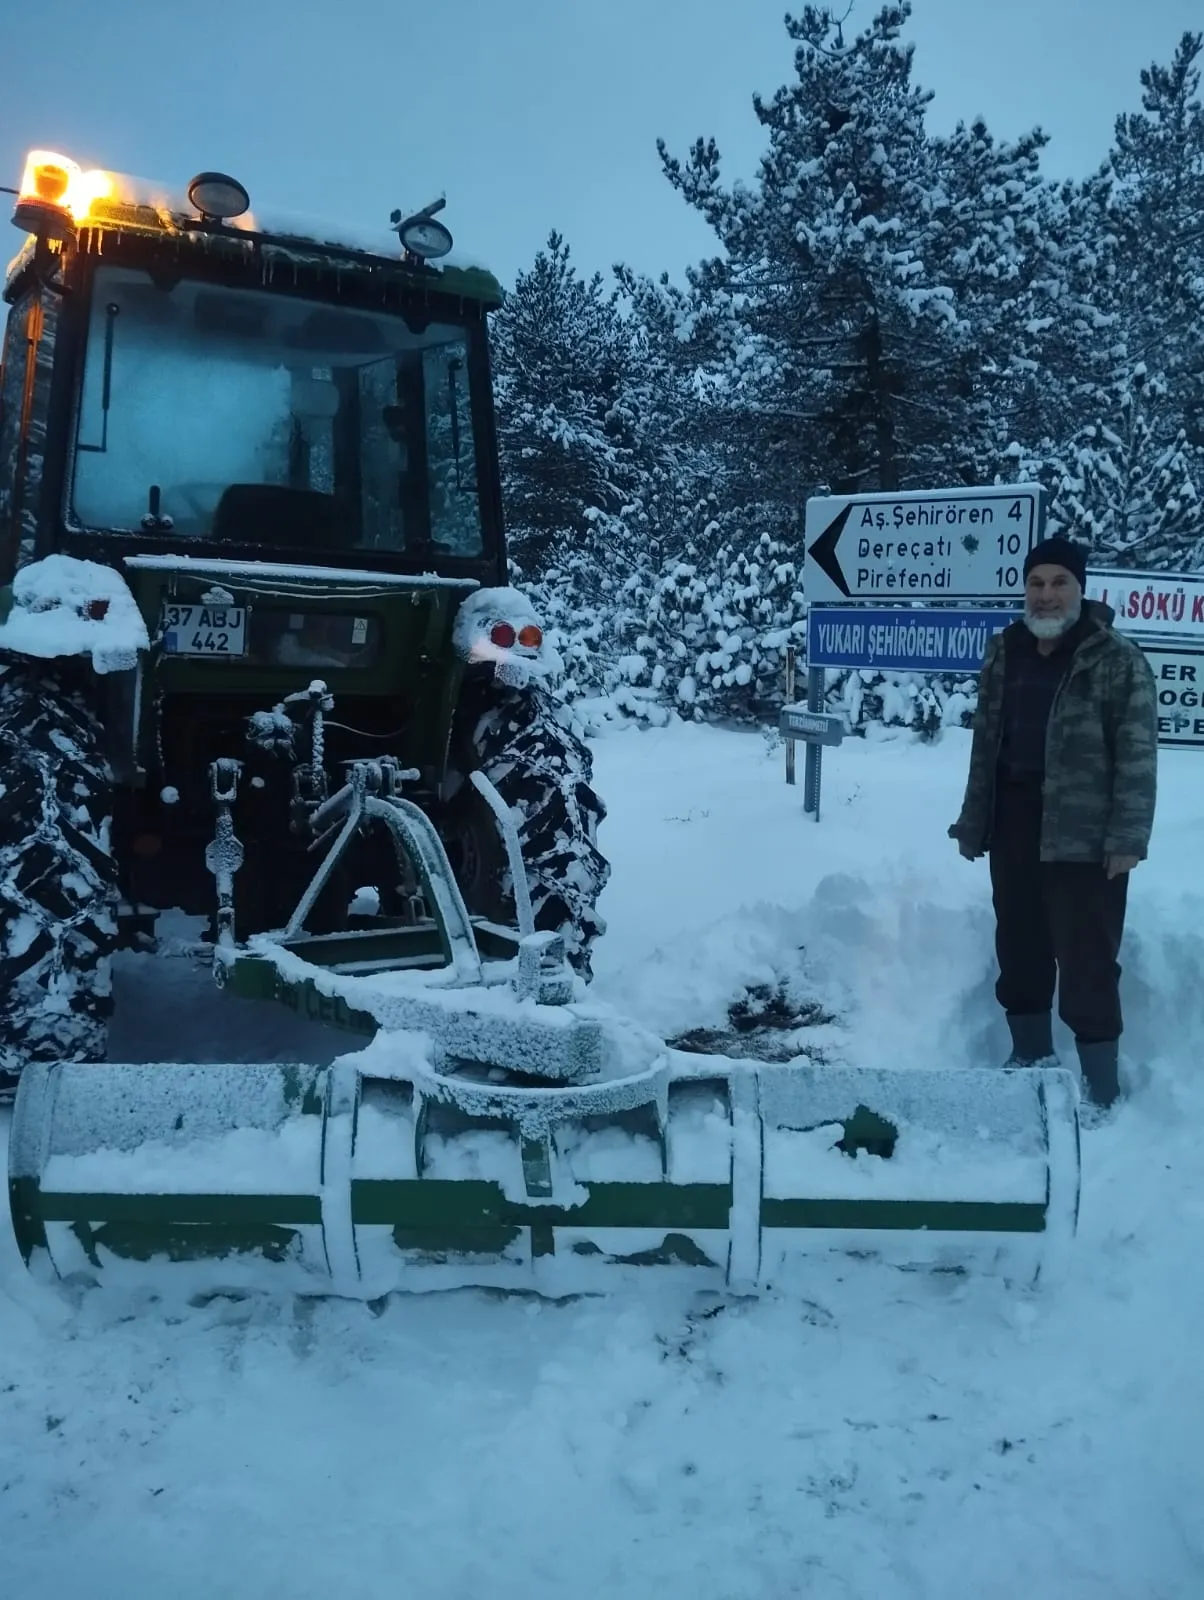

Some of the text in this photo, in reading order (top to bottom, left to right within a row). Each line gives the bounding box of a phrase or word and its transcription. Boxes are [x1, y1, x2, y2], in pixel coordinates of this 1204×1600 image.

[1007, 500, 1022, 522] 4
[858, 533, 1021, 560] Dereçatı 10
[857, 566, 1019, 589] Pirefendi 10
[168, 607, 241, 629] 37 ABJ
[191, 631, 229, 651] 442
[818, 623, 865, 655] YUKARI
[868, 618, 944, 663] ŞEHİRÖREN
[947, 620, 988, 660] KÖYÜ
[1154, 664, 1197, 682] ER
[1159, 687, 1204, 709] OĞ
